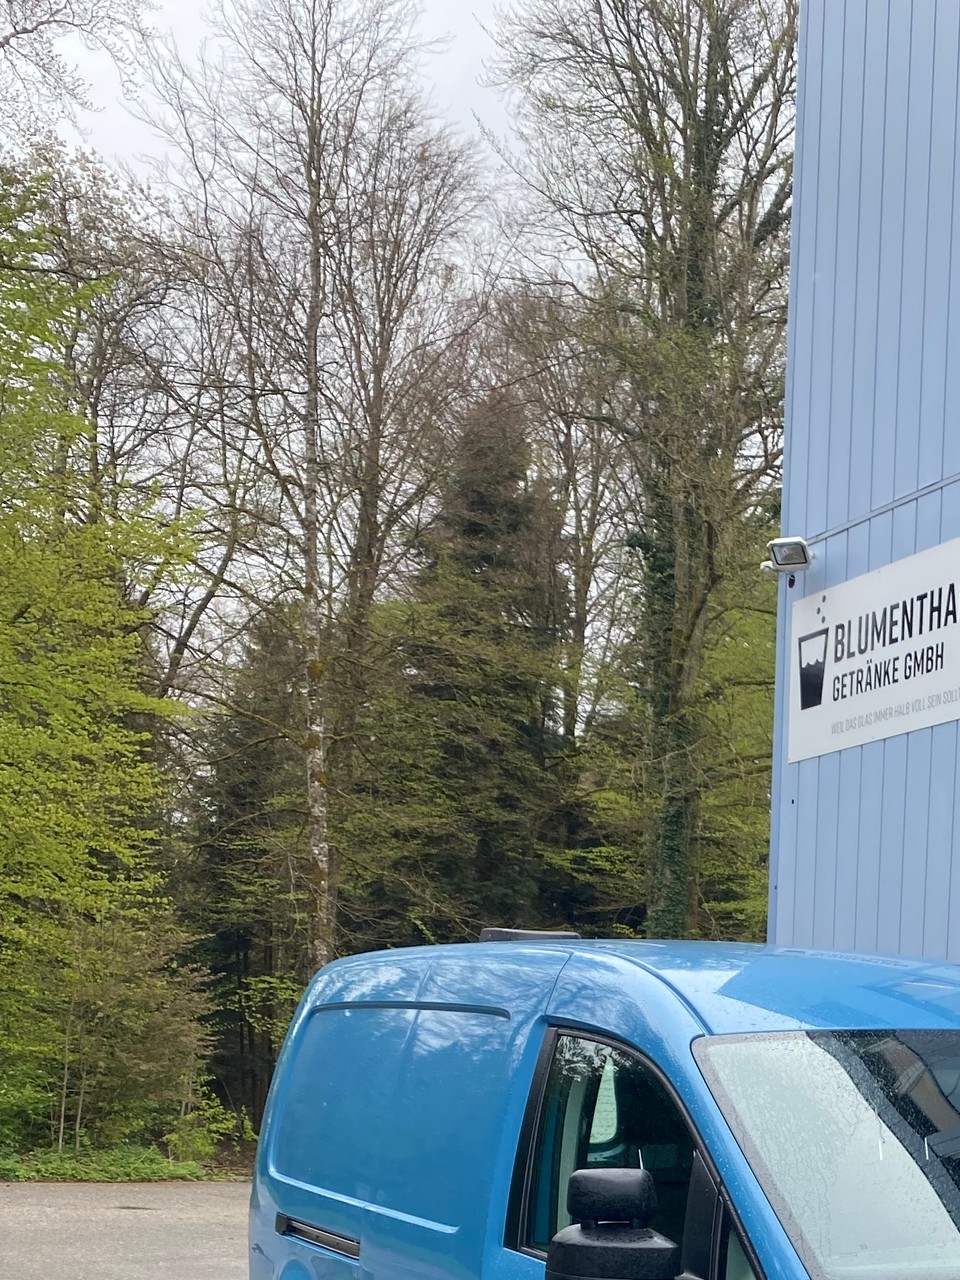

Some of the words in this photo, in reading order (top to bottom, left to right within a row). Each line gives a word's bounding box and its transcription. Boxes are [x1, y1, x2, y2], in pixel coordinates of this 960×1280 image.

[832, 657, 900, 702] GETRÄNKE
[904, 642, 944, 680] GMBH
[845, 716, 857, 732] DAS
[873, 706, 894, 723] IMMER
[894, 701, 910, 716] HALB
[911, 697, 926, 712] VOLL
[927, 692, 942, 708] SEIN
